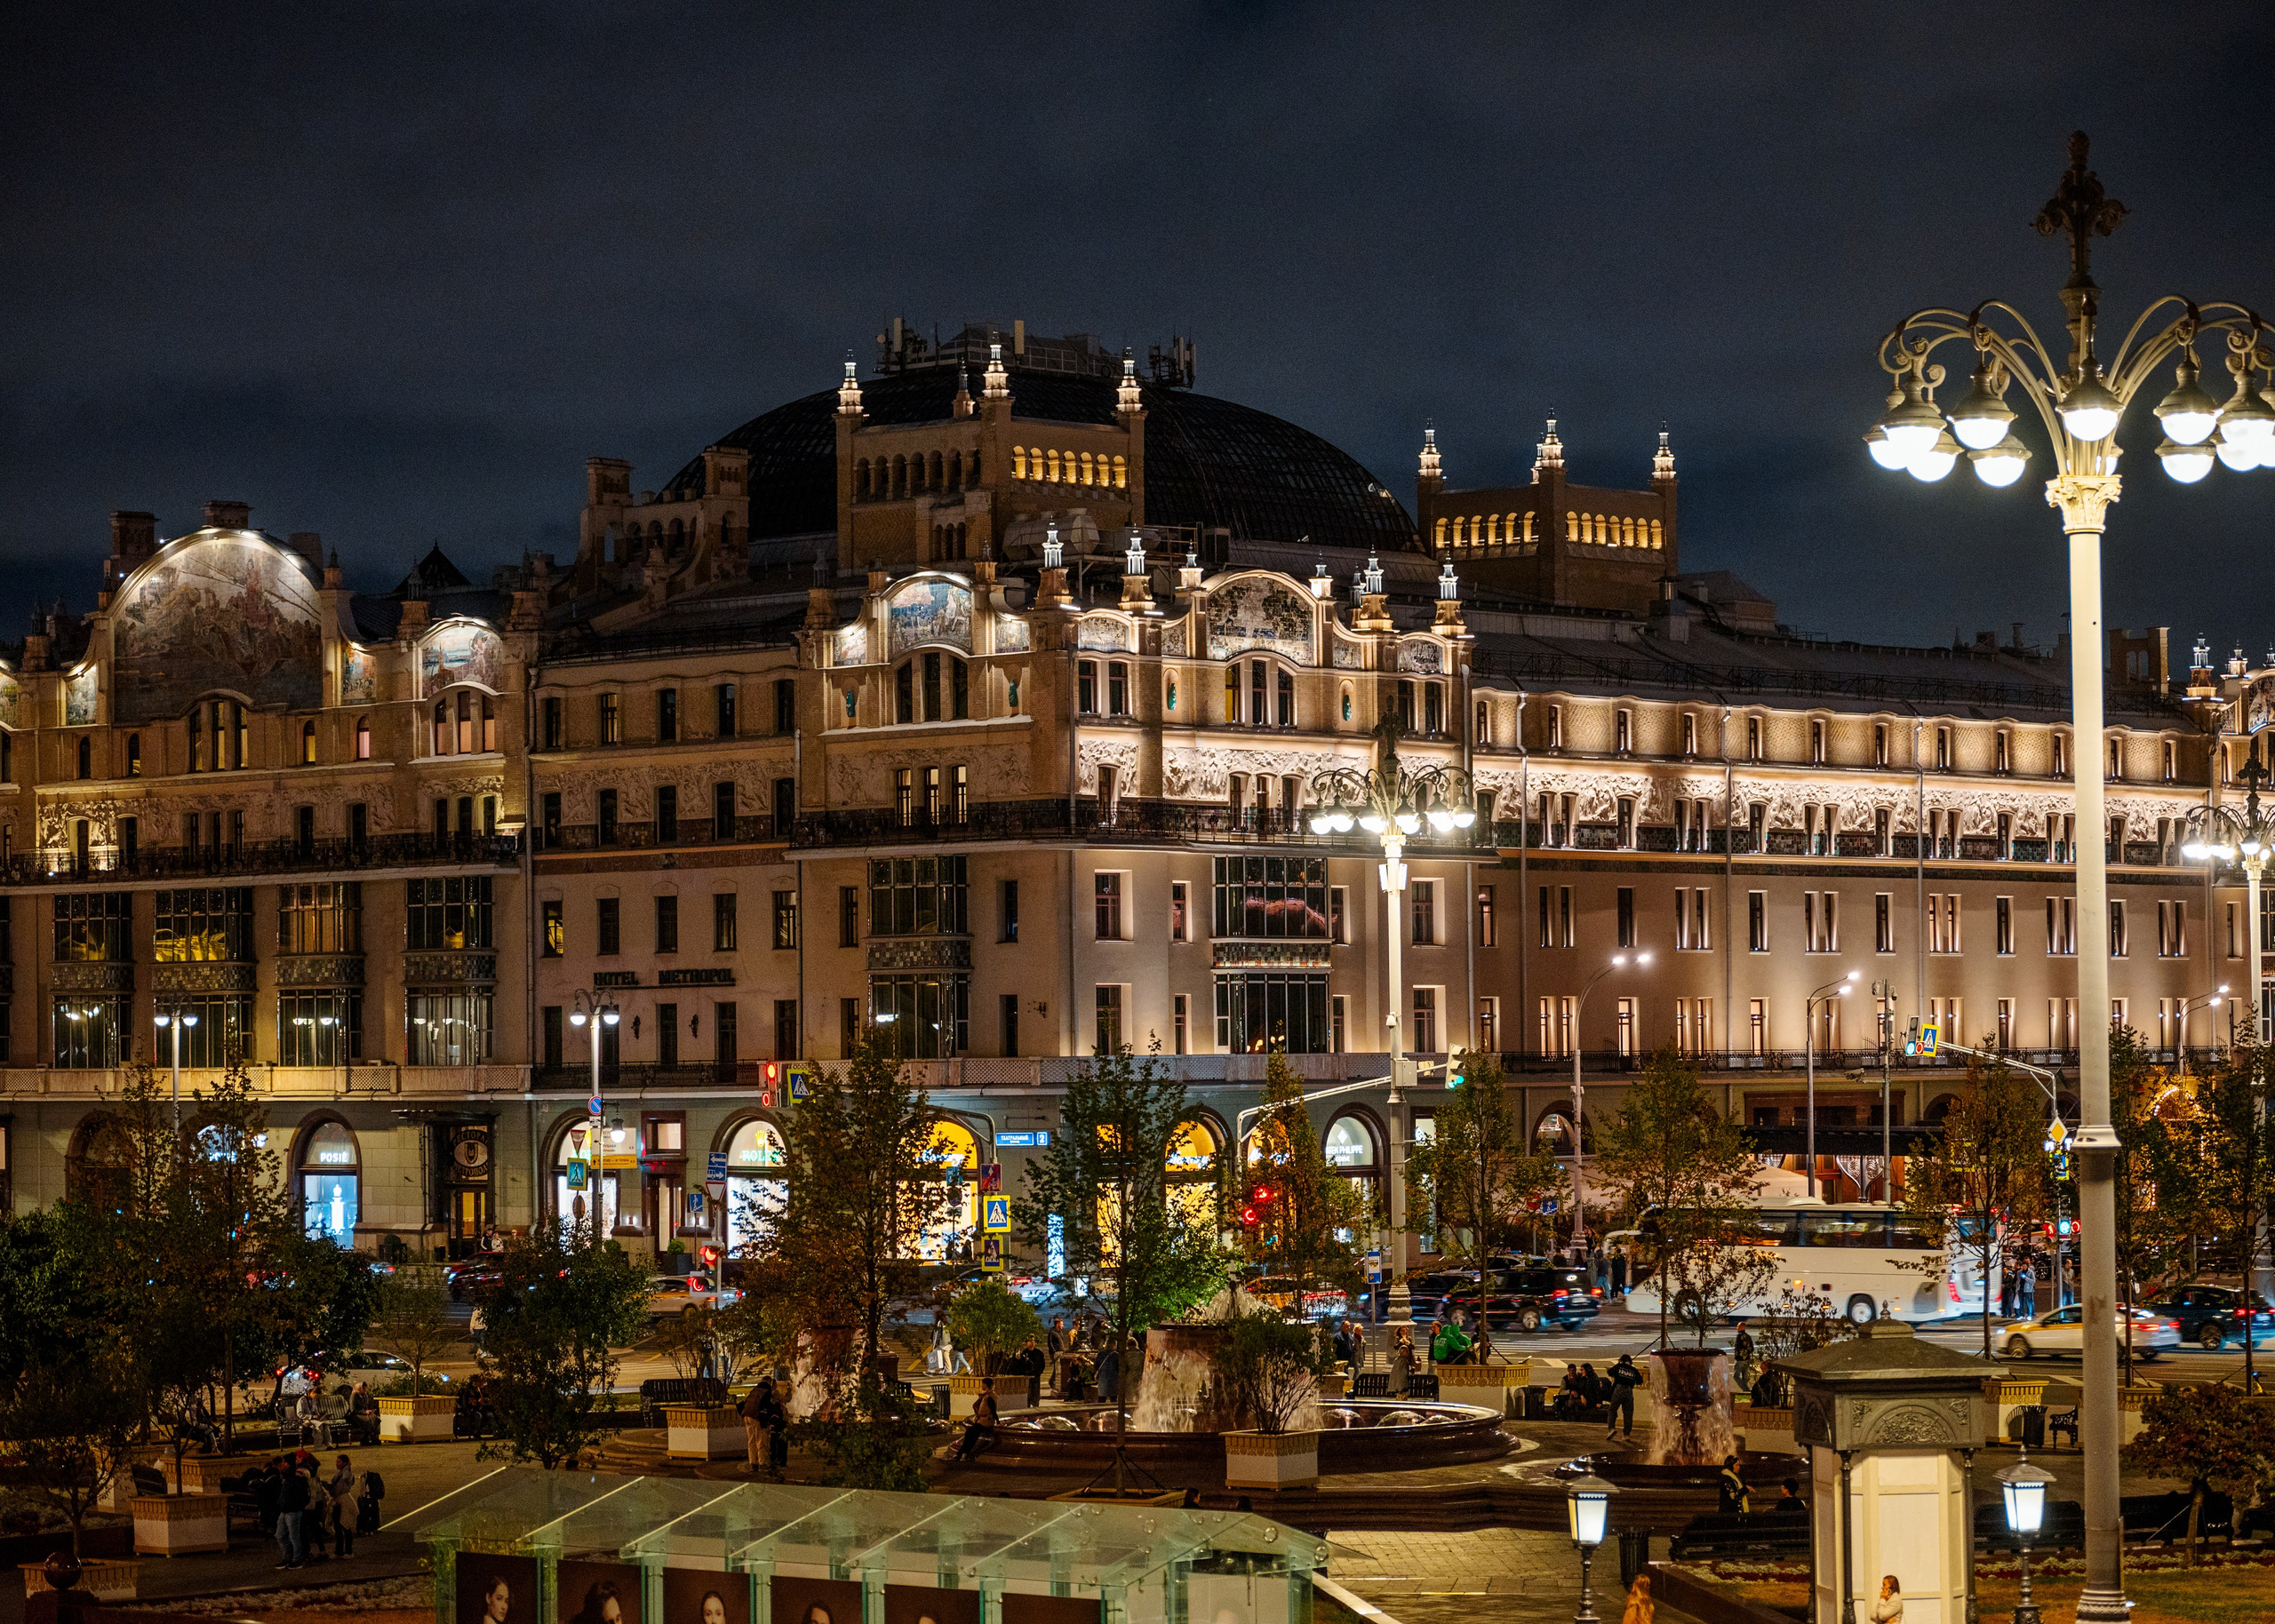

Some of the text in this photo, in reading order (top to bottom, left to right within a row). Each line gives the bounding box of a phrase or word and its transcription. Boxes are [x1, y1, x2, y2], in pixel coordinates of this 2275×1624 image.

[594, 968, 736, 985] HOTEL METROPOL
[453, 1131, 488, 1147] РЕСТОРА
[1040, 1134, 1045, 1143] 2
[1339, 1144, 1363, 1154] PHILIPPE
